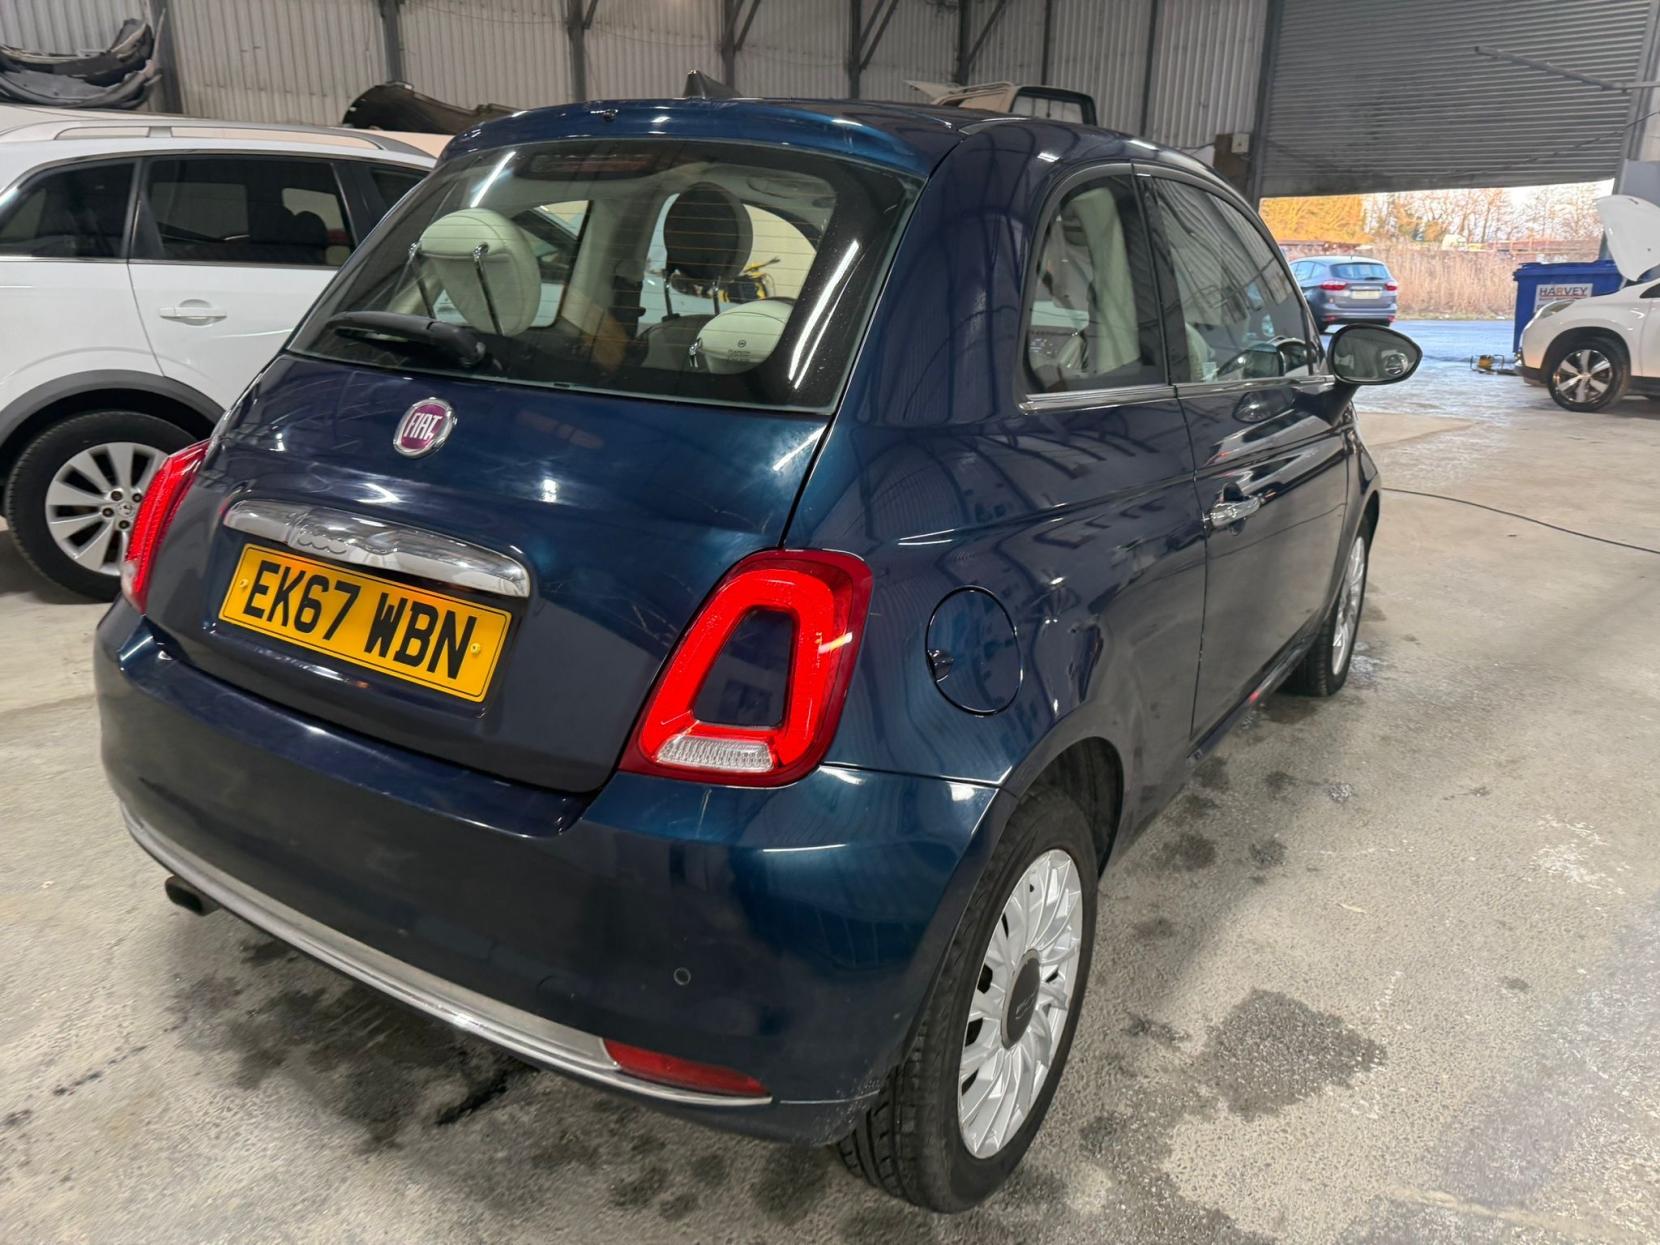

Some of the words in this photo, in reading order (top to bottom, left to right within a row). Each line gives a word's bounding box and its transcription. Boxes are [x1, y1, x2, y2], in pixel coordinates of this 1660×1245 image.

[1540, 287, 1588, 296] HARVEY
[403, 412, 443, 440] FIAT
[242, 560, 361, 641] EK67
[363, 592, 477, 680] WBN
